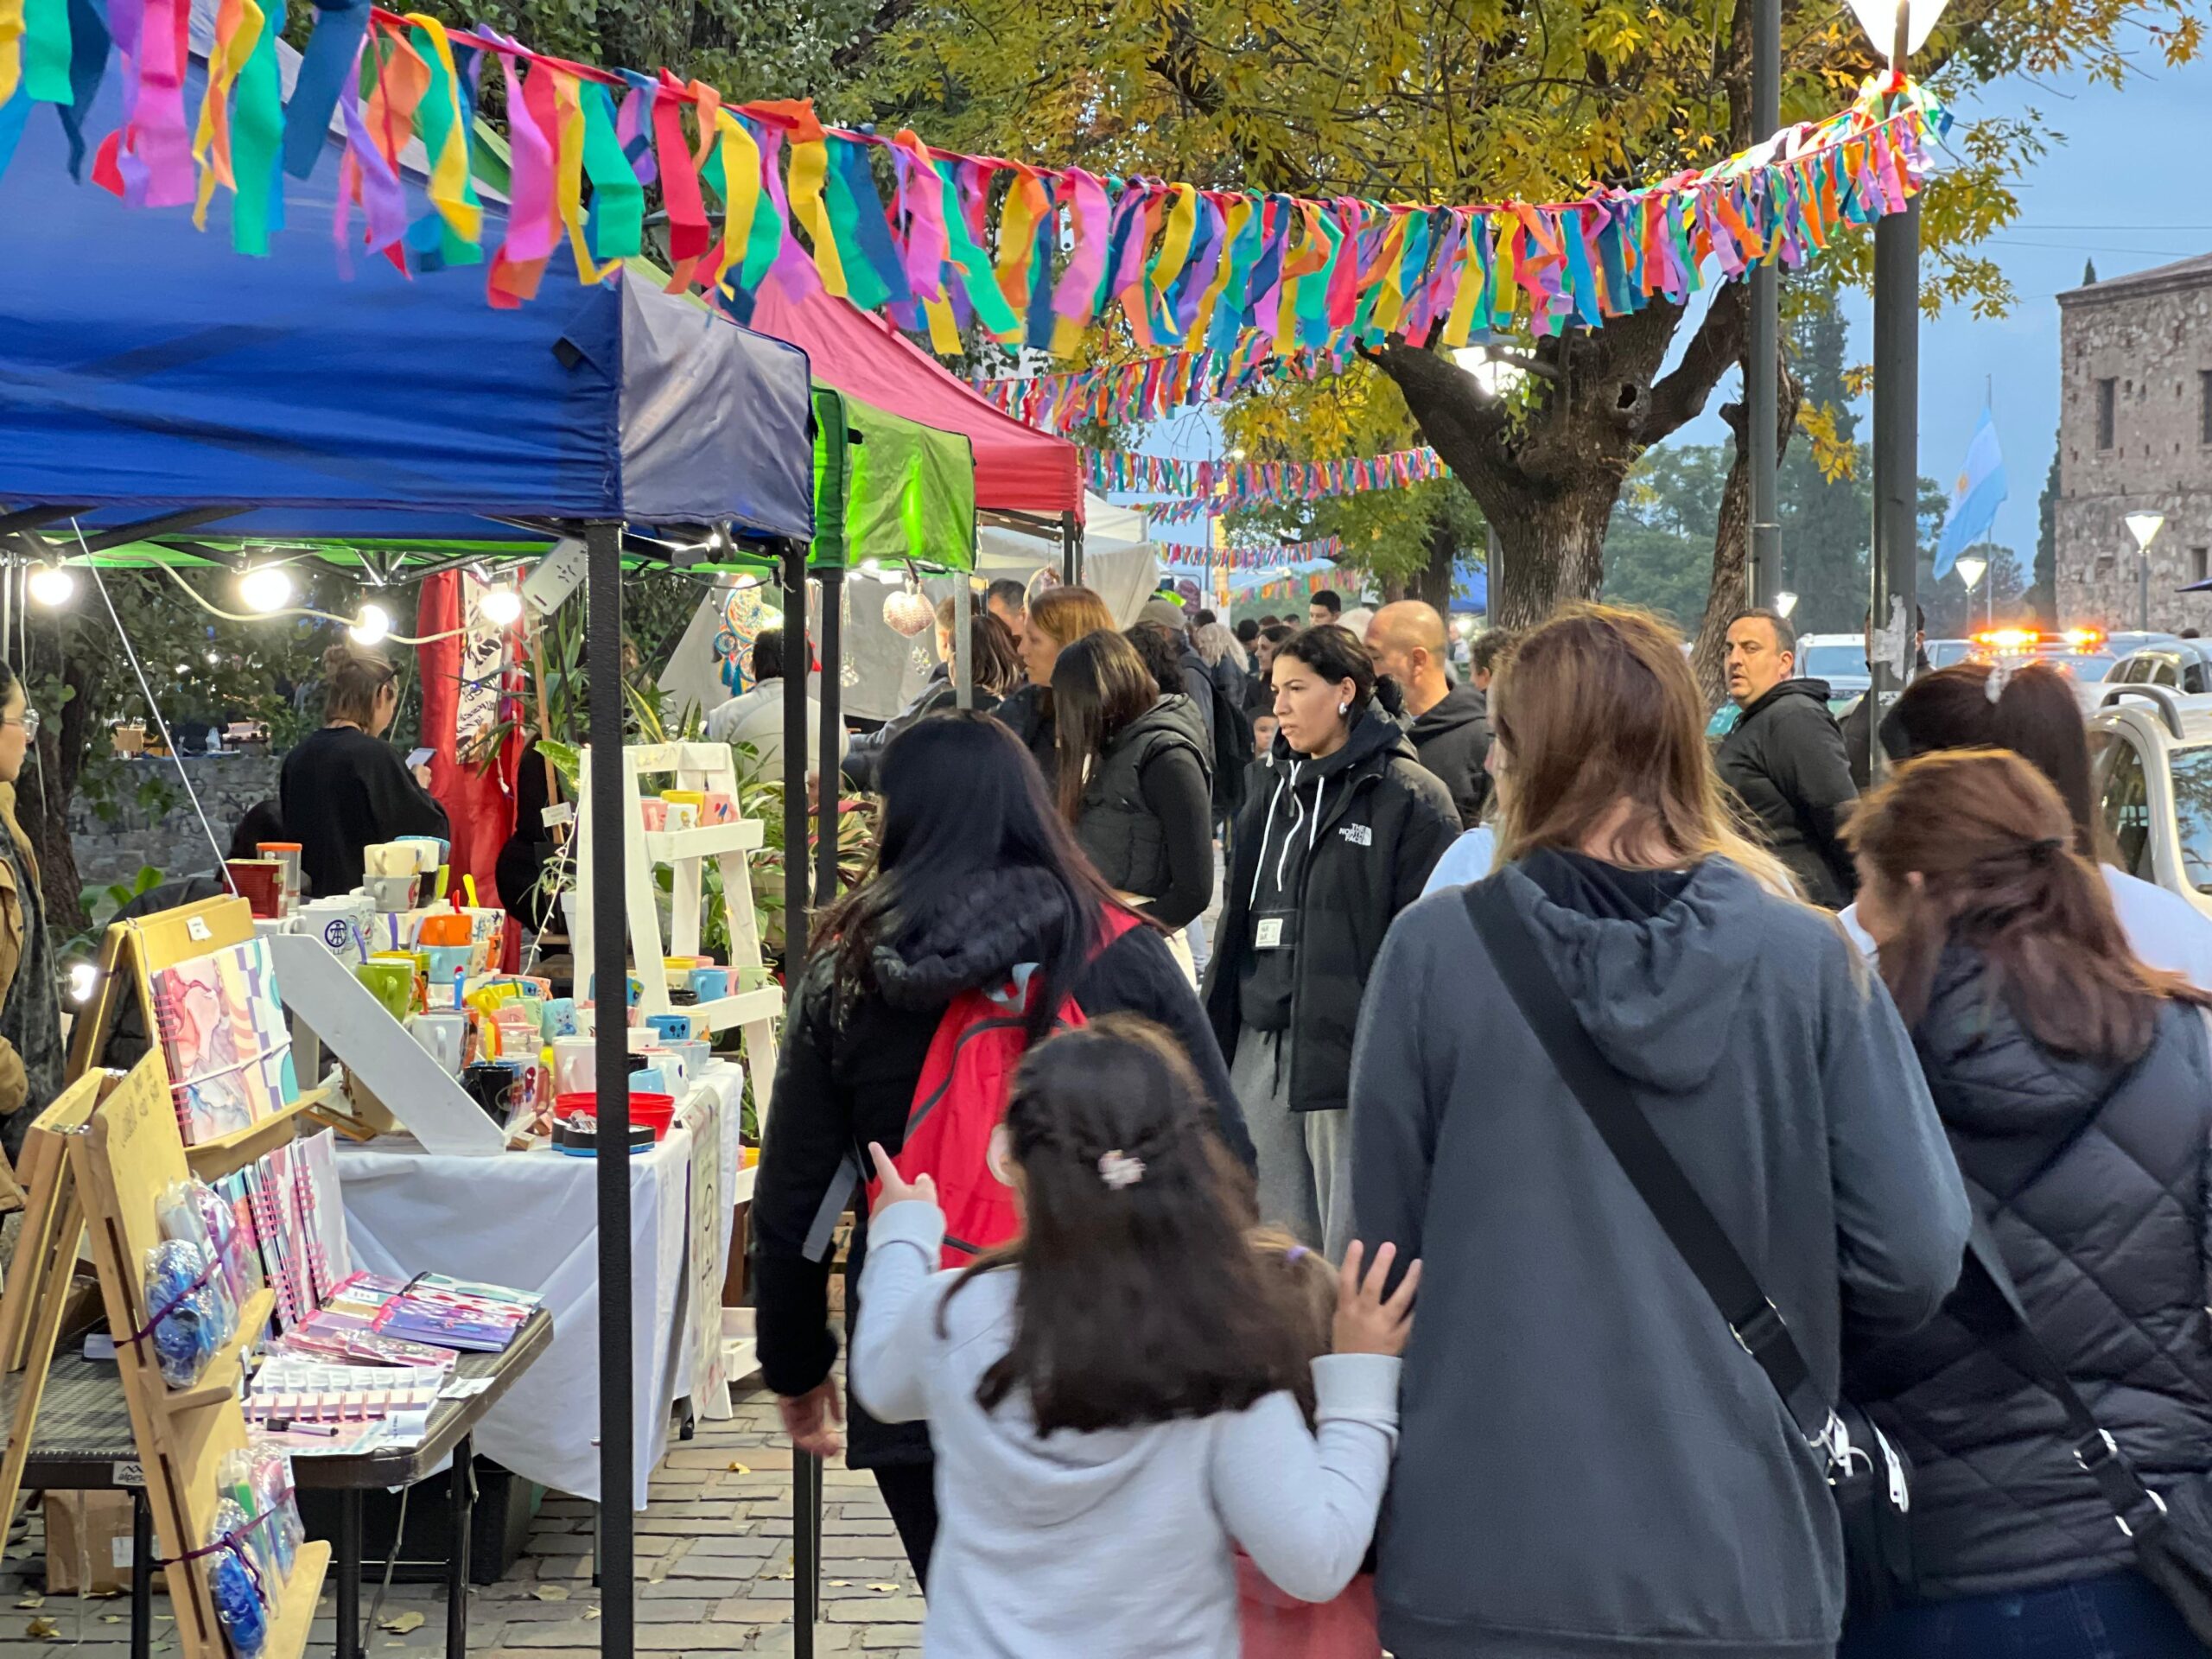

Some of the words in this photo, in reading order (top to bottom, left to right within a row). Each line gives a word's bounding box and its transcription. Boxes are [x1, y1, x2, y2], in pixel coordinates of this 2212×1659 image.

[1351, 823, 1365, 831] THE
[1338, 827, 1365, 838] NORTH
[1345, 834, 1363, 844] FACE
